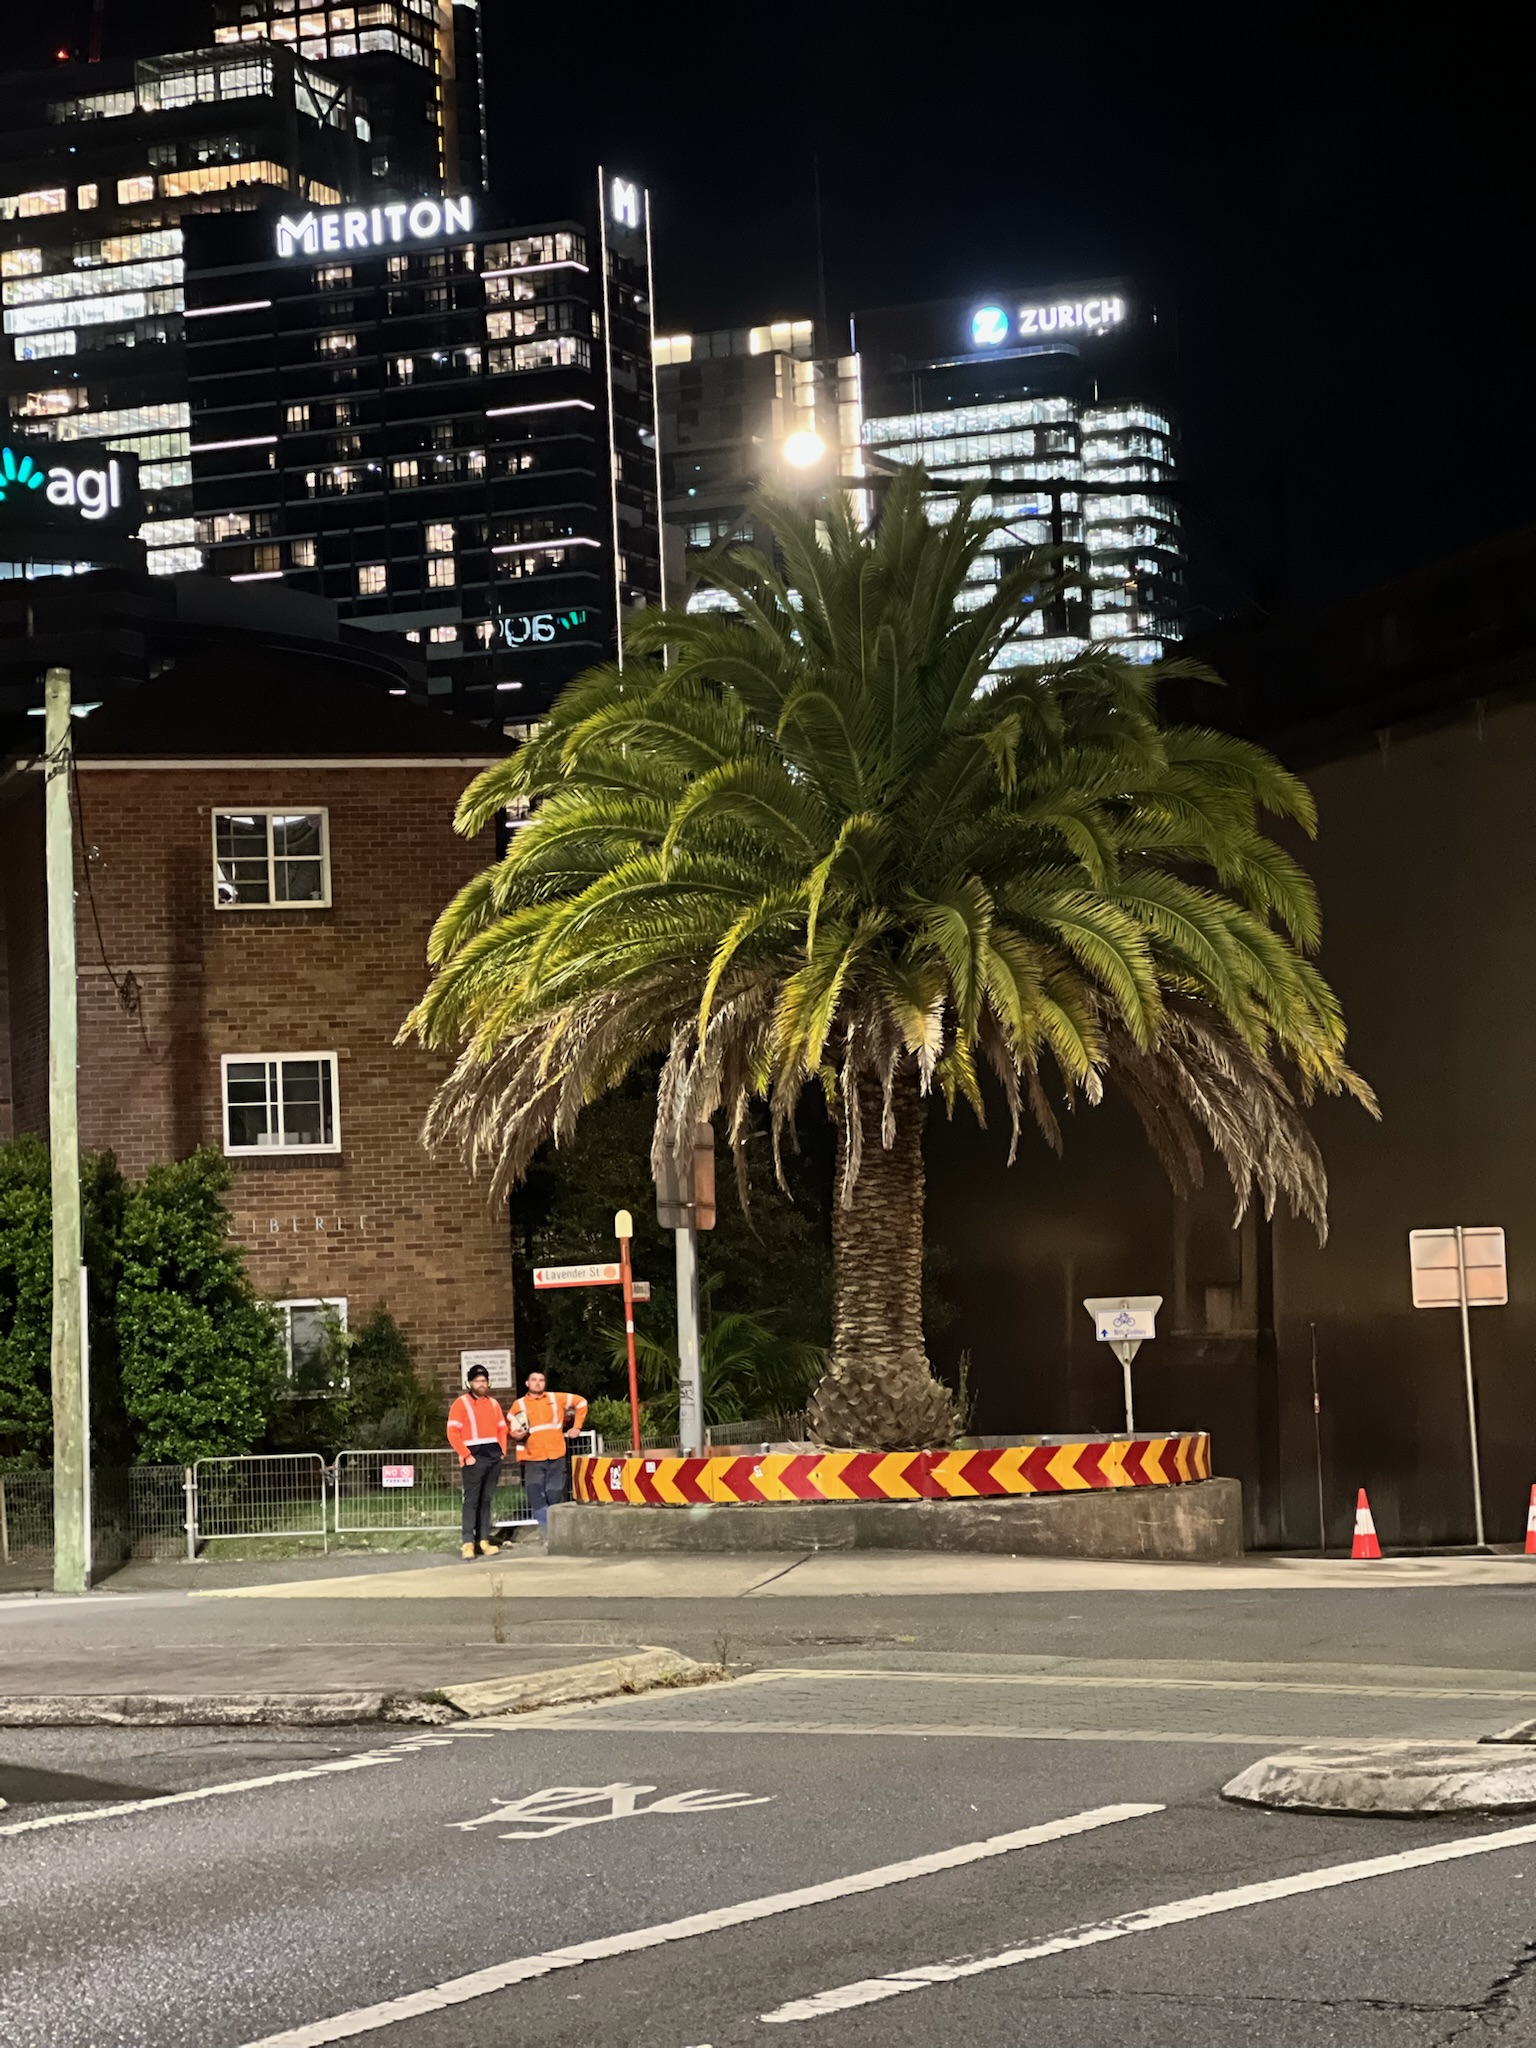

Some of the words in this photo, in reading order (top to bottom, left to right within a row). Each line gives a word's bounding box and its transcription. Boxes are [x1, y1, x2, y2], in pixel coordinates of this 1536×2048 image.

[276, 196, 472, 257] MERITON
[1019, 298, 1121, 334] ZURICH
[46, 459, 120, 519] agl
[545, 1268, 586, 1281] Lavender
[589, 1266, 600, 1278] St
[385, 1469, 397, 1477] NO
